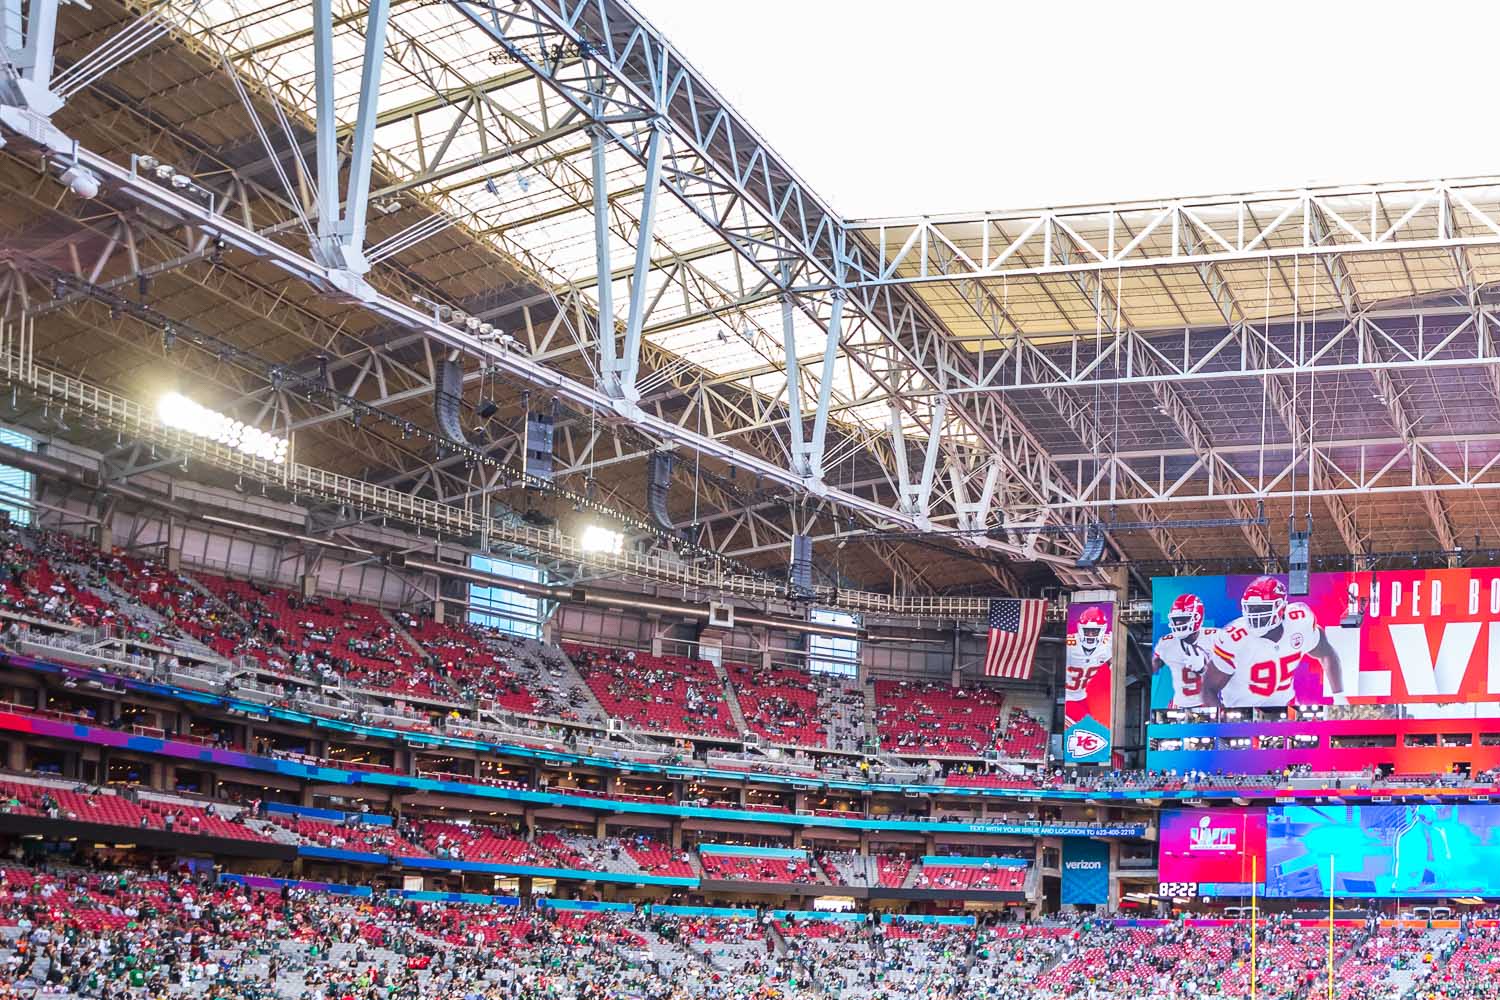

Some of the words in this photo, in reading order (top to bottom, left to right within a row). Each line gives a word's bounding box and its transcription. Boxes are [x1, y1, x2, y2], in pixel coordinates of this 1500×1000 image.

[1347, 580, 1442, 618] SUPER
[1249, 653, 1301, 697] 95
[1077, 735, 1098, 751] KC
[1065, 859, 1101, 870] verizon
